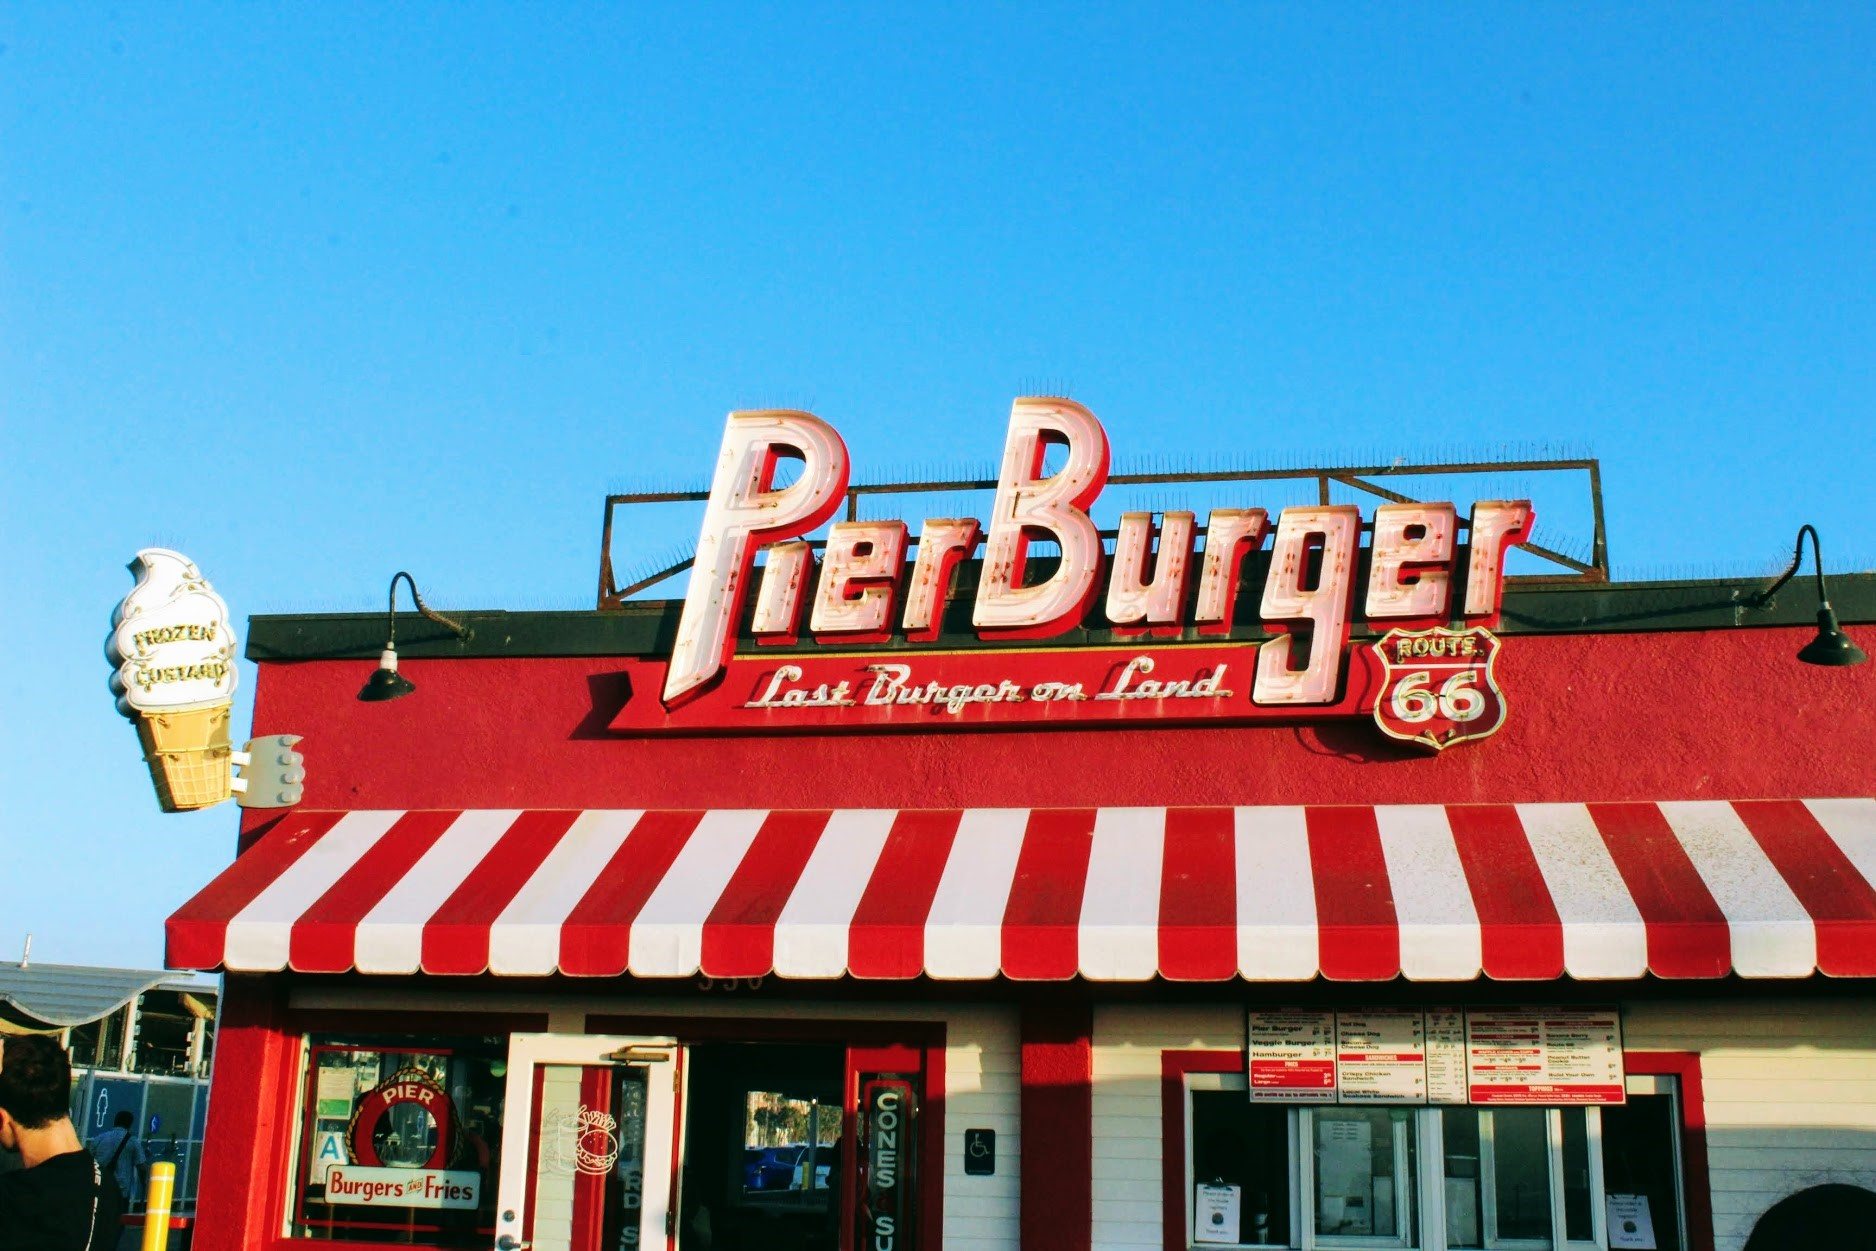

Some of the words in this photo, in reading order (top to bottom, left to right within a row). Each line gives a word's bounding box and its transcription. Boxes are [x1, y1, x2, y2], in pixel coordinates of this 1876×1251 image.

[664, 409, 982, 712] Pier
[972, 396, 1535, 705] Burger
[133, 624, 215, 650] FROZEN
[1396, 636, 1478, 658] ROUTE
[135, 662, 229, 686] CUSTARD
[745, 664, 856, 708] Last
[865, 663, 1023, 714] Burger
[1030, 681, 1088, 702] on
[1094, 656, 1234, 700] Land
[1391, 670, 1486, 723] 66
[382, 1084, 434, 1105] PIER
[320, 1135, 339, 1160] A
[876, 1092, 899, 1188] CONES
[331, 1171, 403, 1201] Burgers
[424, 1175, 473, 1200] Fries
